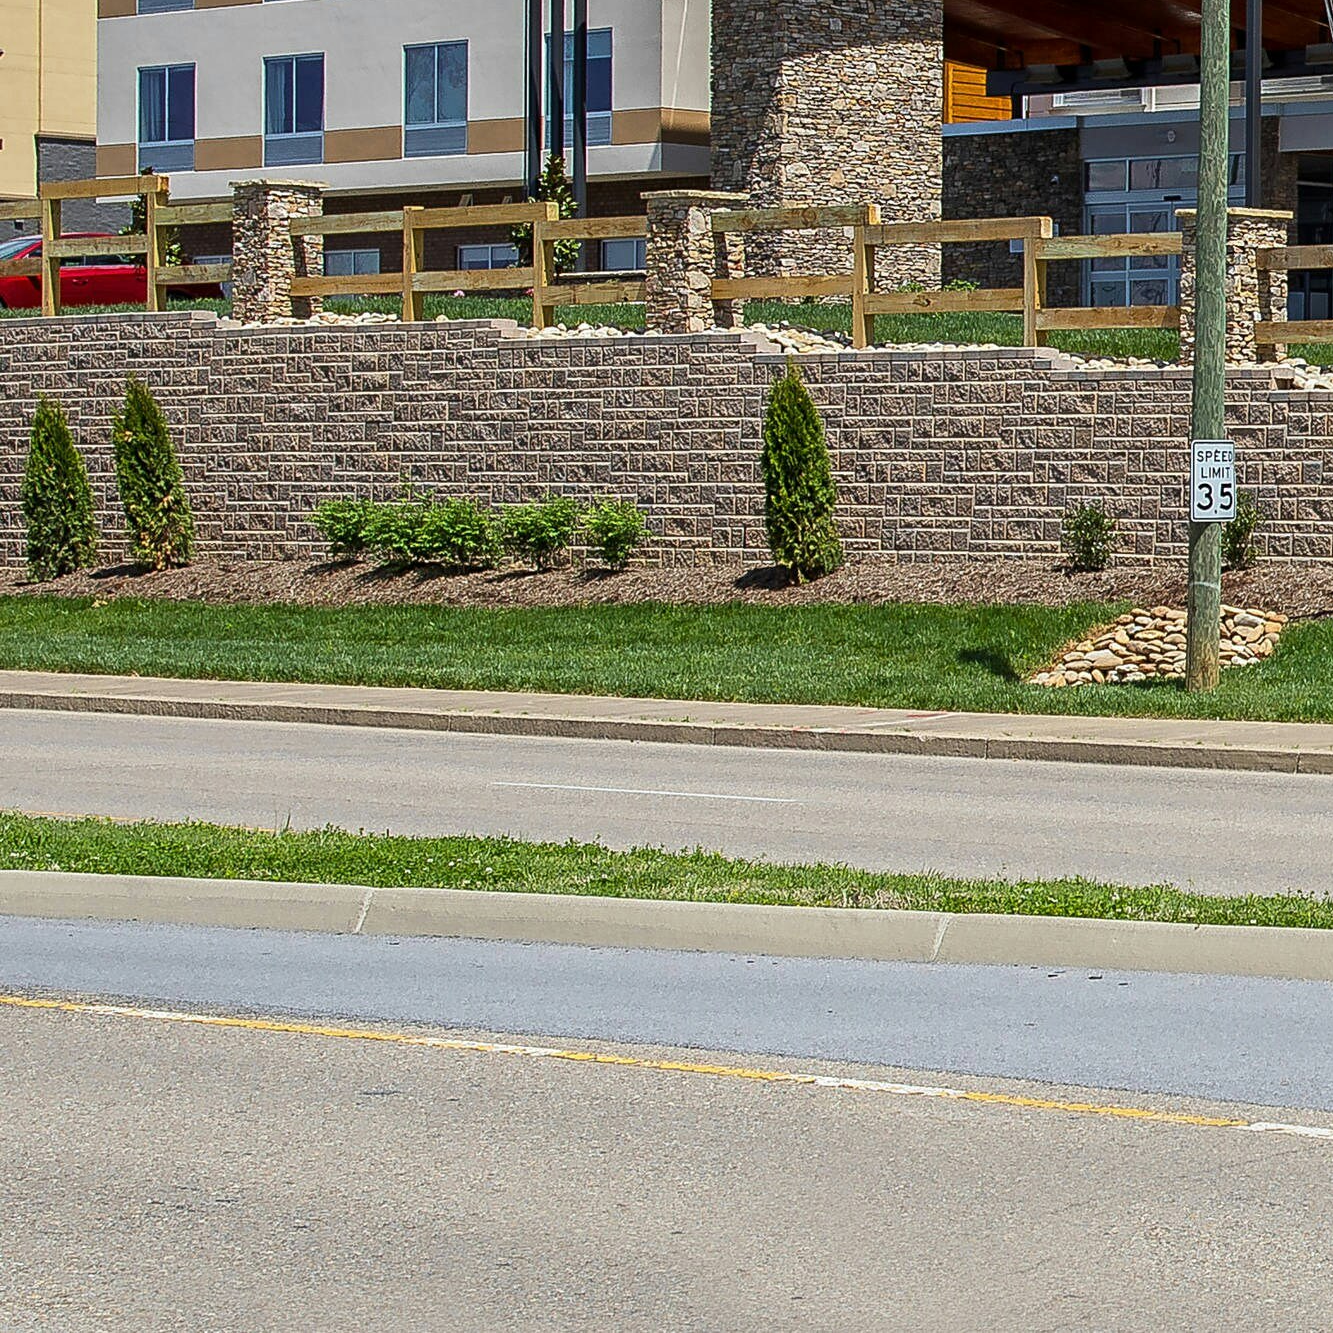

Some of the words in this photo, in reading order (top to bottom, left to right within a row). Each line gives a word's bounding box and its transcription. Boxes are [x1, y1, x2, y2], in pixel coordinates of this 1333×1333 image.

[1196, 450, 1233, 462] SPEED
[1201, 467, 1231, 479] LIMIT
[1197, 483, 1233, 511] 35
